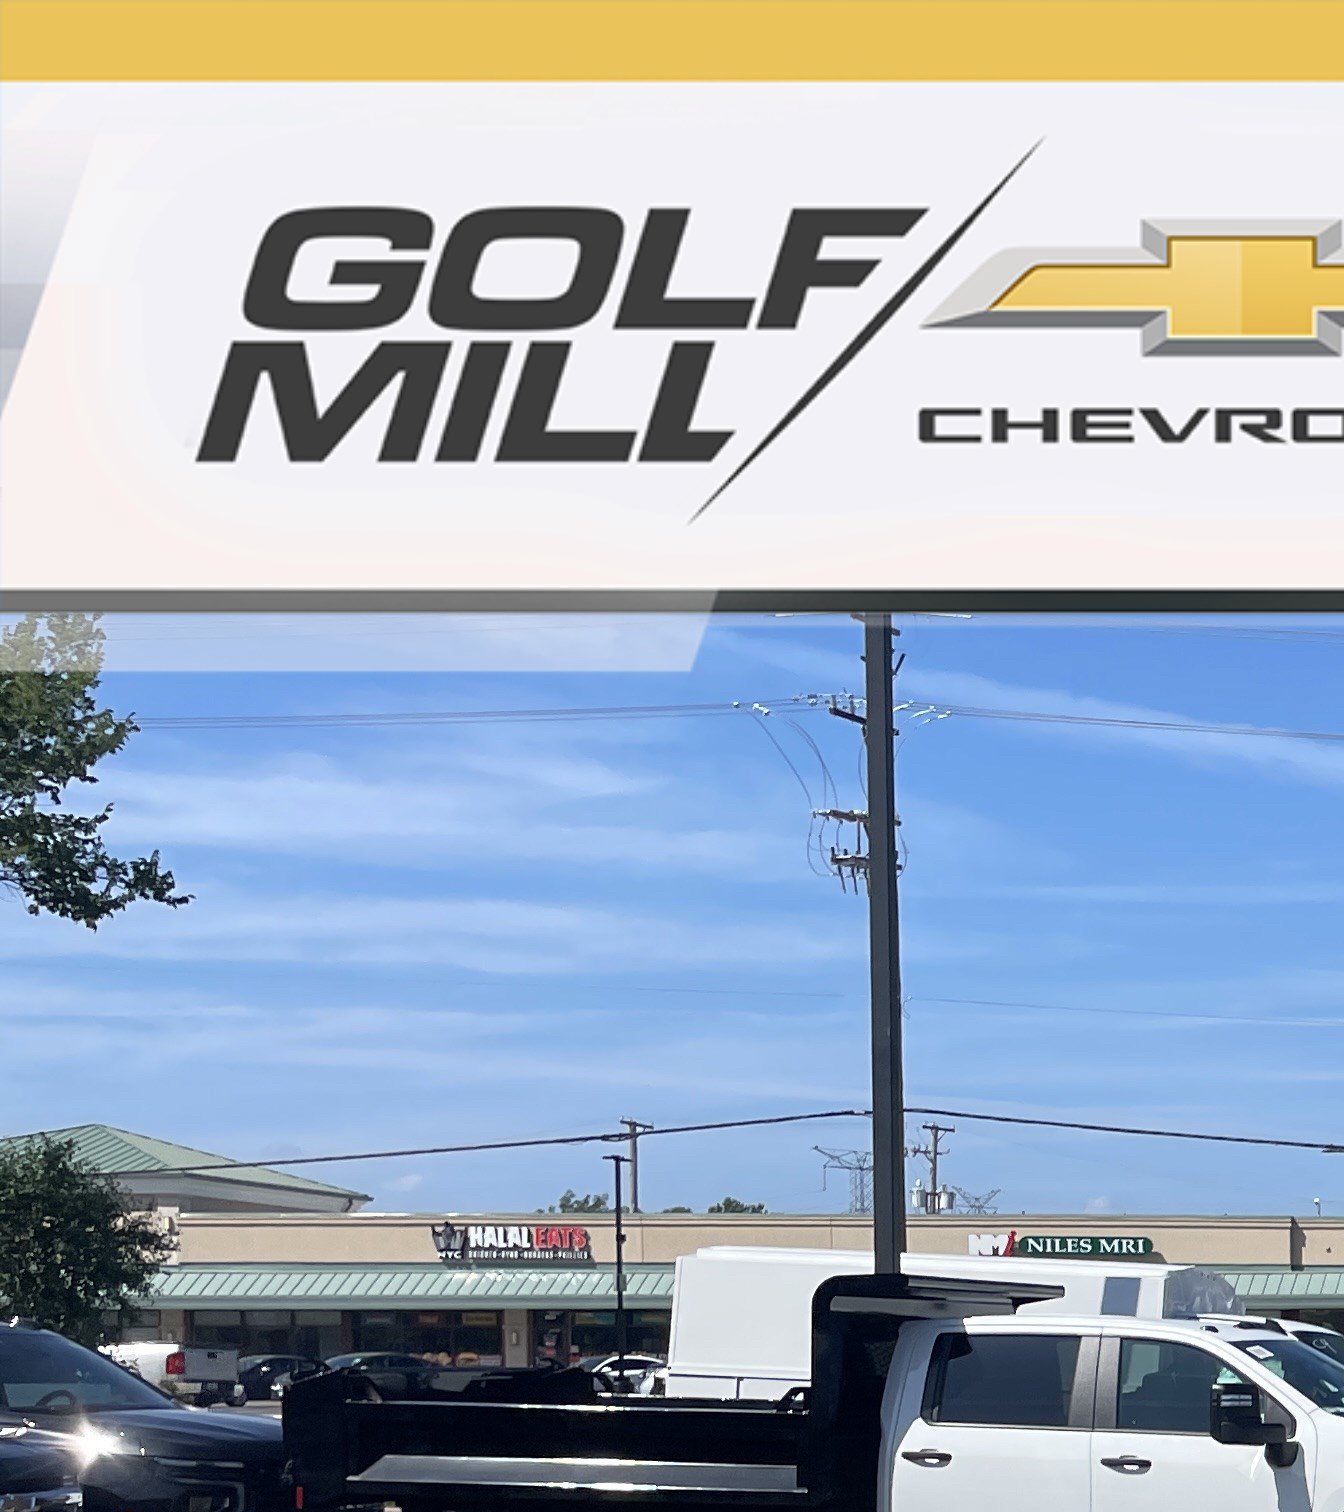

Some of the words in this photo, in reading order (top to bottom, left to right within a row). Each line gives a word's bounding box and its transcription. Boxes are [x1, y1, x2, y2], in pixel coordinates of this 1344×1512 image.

[468, 1226, 532, 1249] HALAL
[534, 1227, 588, 1249] EATS
[1027, 1238, 1093, 1253] NILES
[1099, 1238, 1145, 1254] MRI
[438, 1250, 463, 1259] NYC
